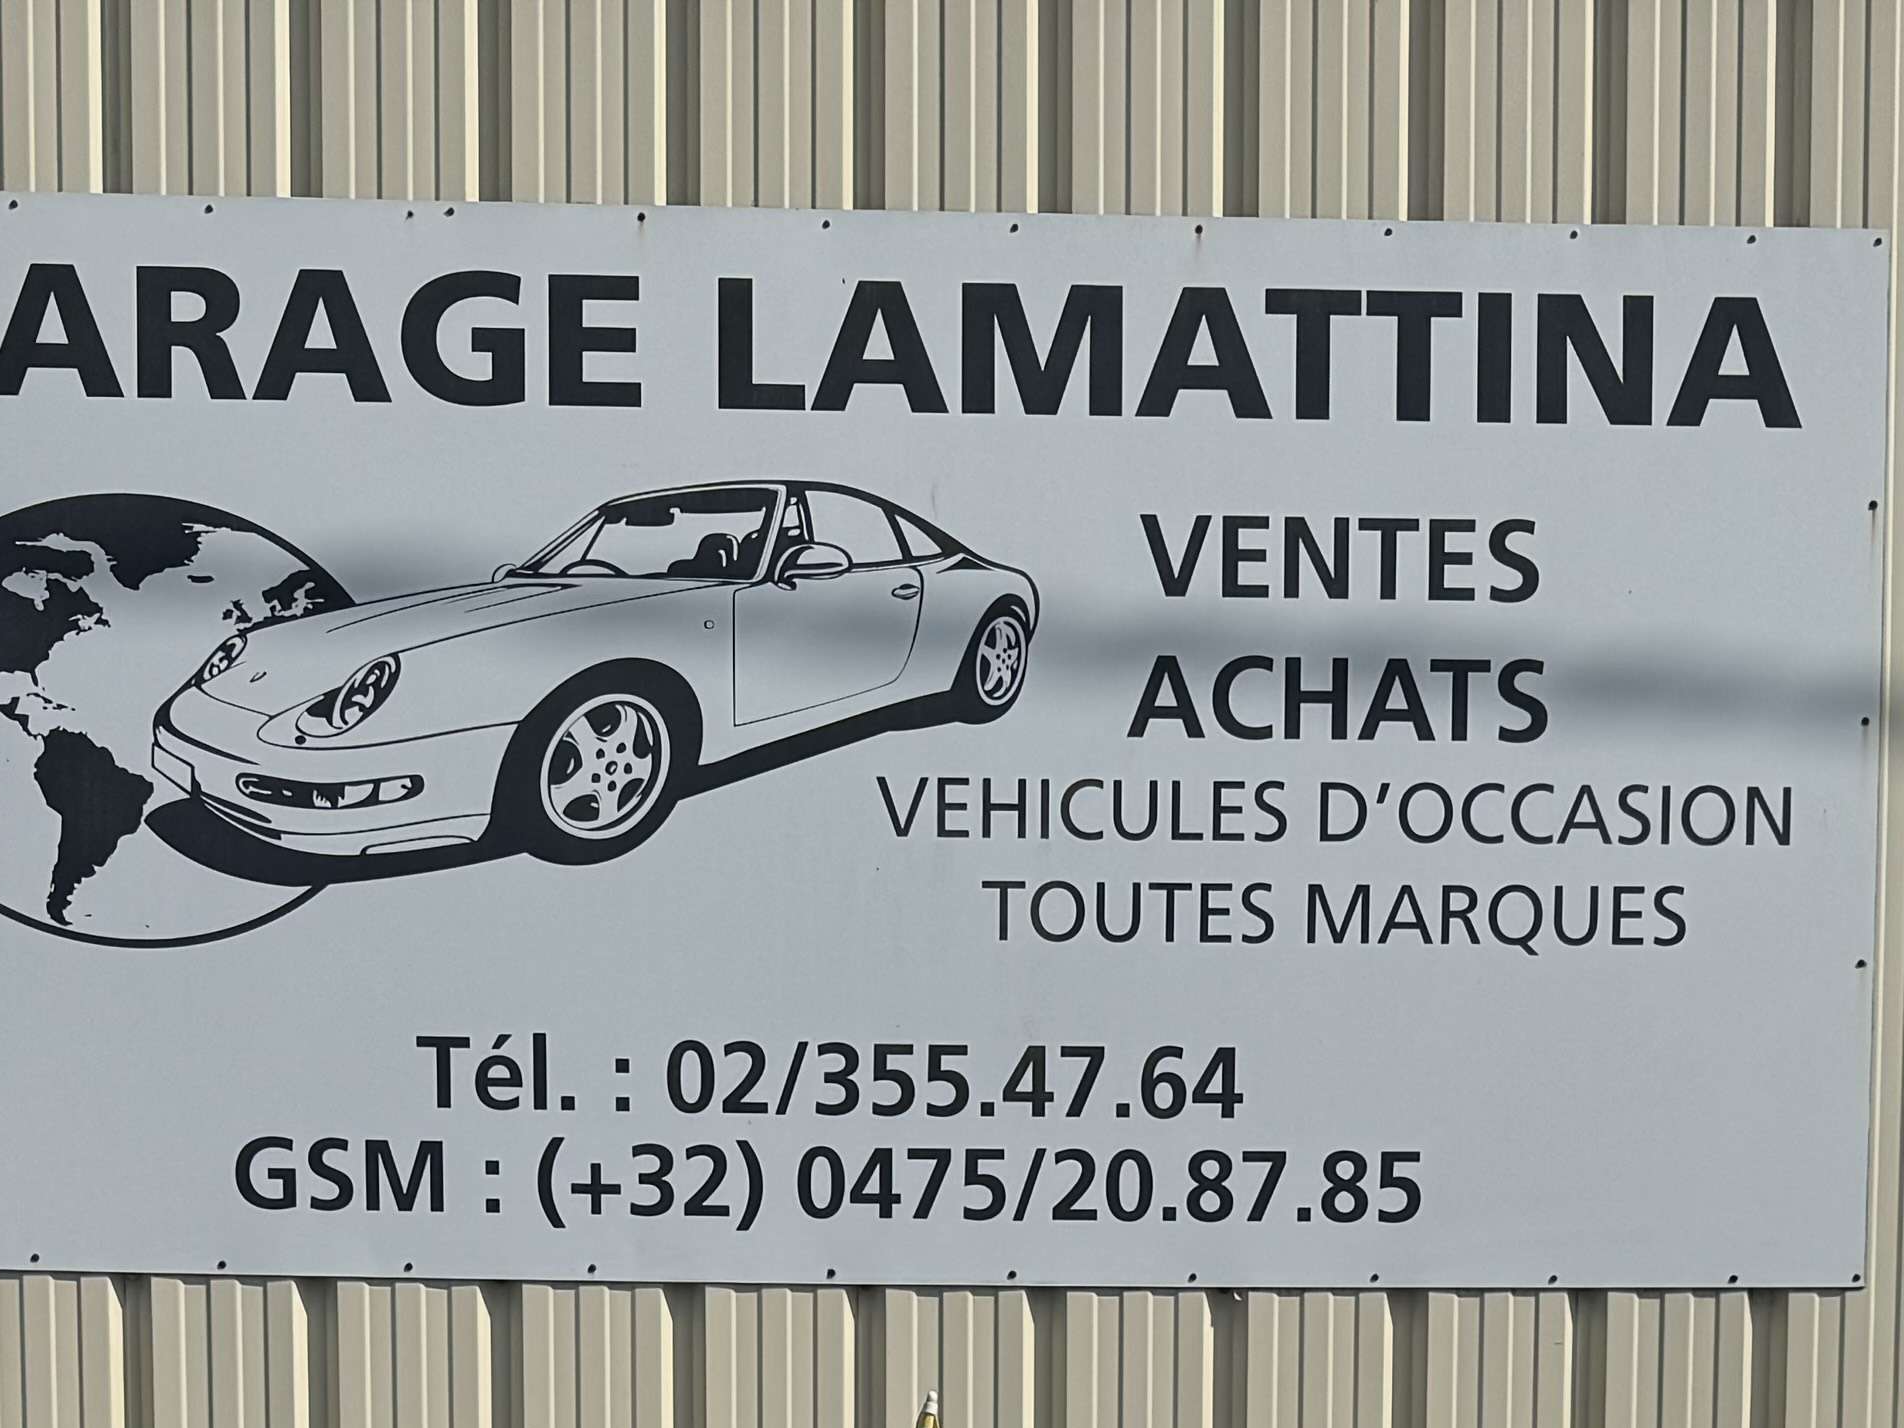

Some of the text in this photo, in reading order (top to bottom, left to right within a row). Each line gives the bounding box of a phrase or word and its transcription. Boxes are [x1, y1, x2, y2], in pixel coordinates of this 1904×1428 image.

[718, 287, 1803, 429] LAMATTINA
[1139, 514, 1540, 603] VENTES
[1126, 655, 1548, 744] ACHATS
[877, 776, 1288, 843] VEHICULES
[982, 881, 1687, 956] TOUTES MARQUES
[415, 1032, 576, 1111] Tél.
[666, 1039, 1244, 1120] 02/355.47.64
[235, 1135, 445, 1213] GSM
[537, 1136, 764, 1232] (+32)
[797, 1145, 1422, 1224] 0475/20.87.85
